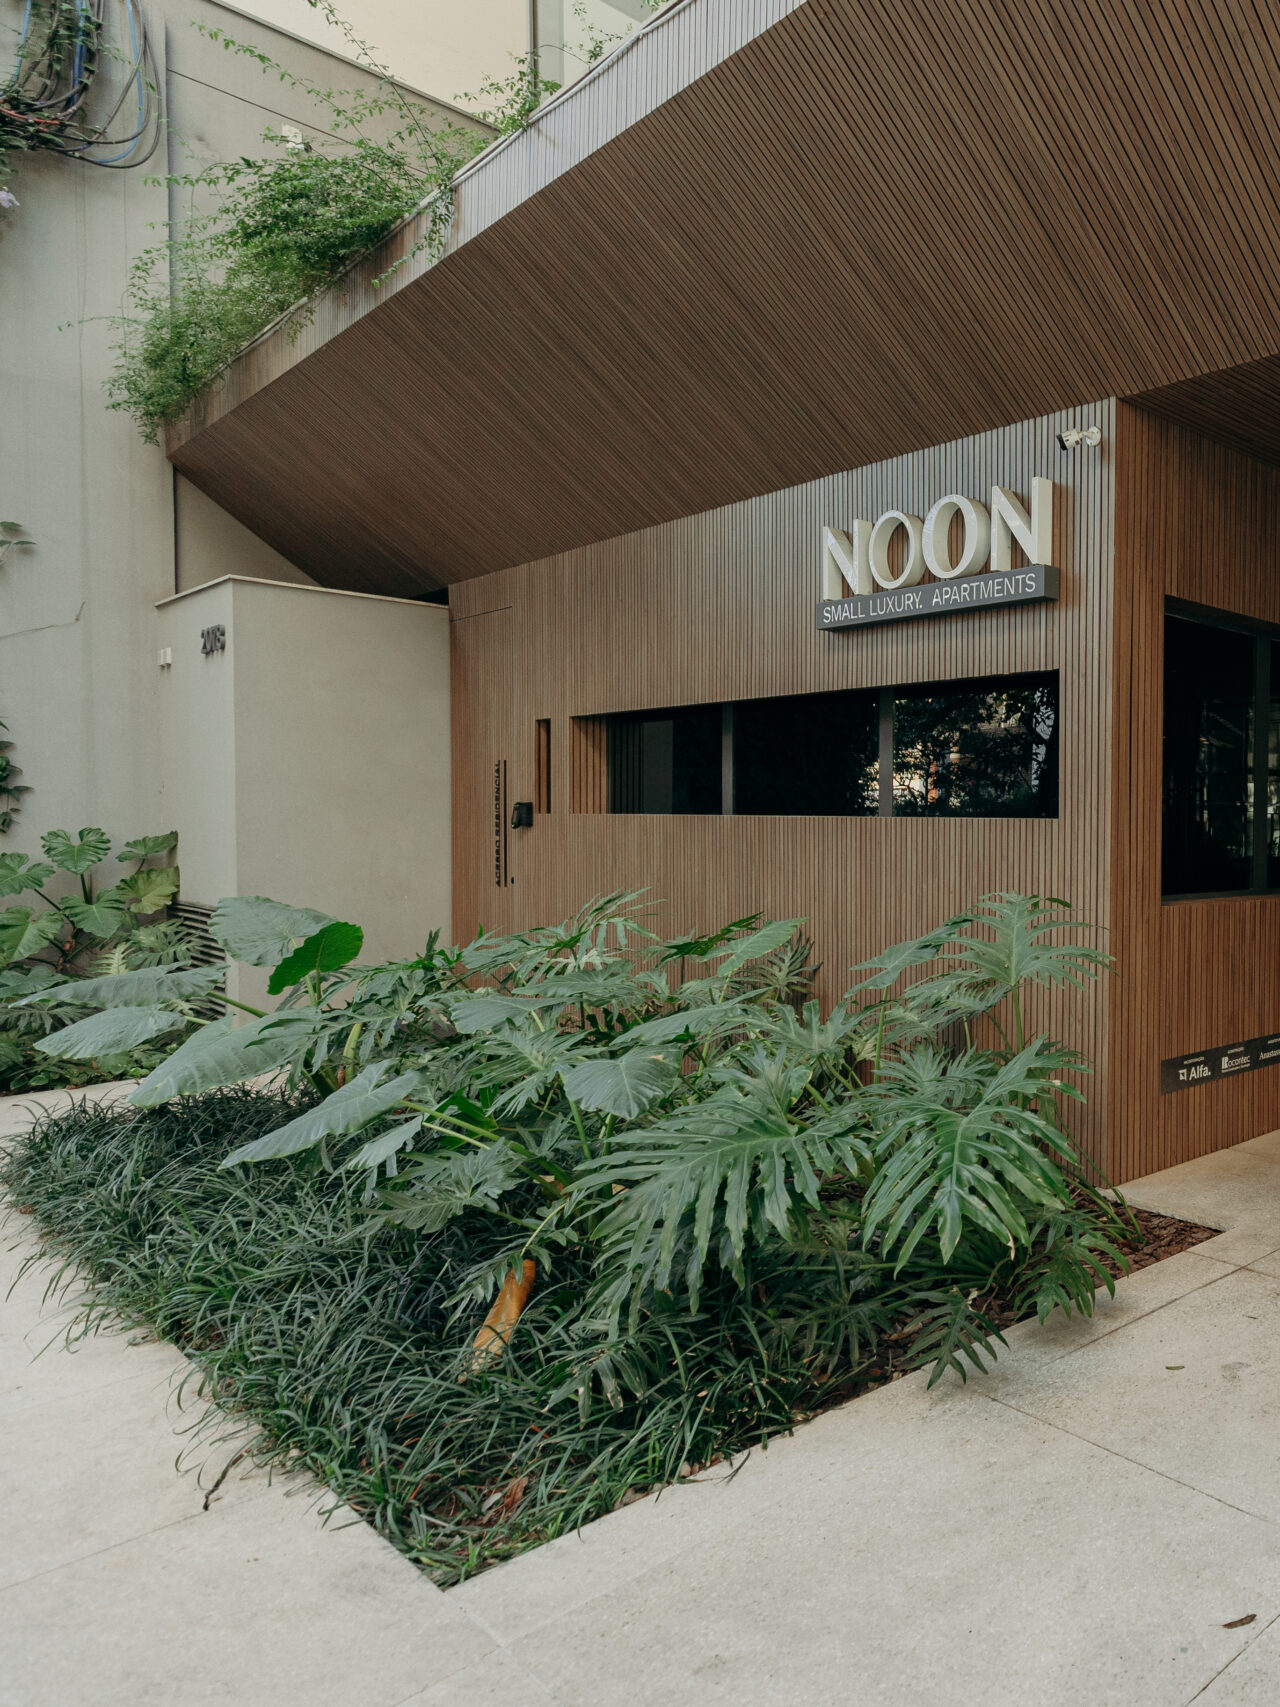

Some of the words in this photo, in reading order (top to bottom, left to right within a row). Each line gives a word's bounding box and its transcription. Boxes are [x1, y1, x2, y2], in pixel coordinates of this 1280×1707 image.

[823, 476, 1052, 600] NOON
[823, 603, 866, 624] SMALL
[932, 572, 1036, 606] APARTMENTS
